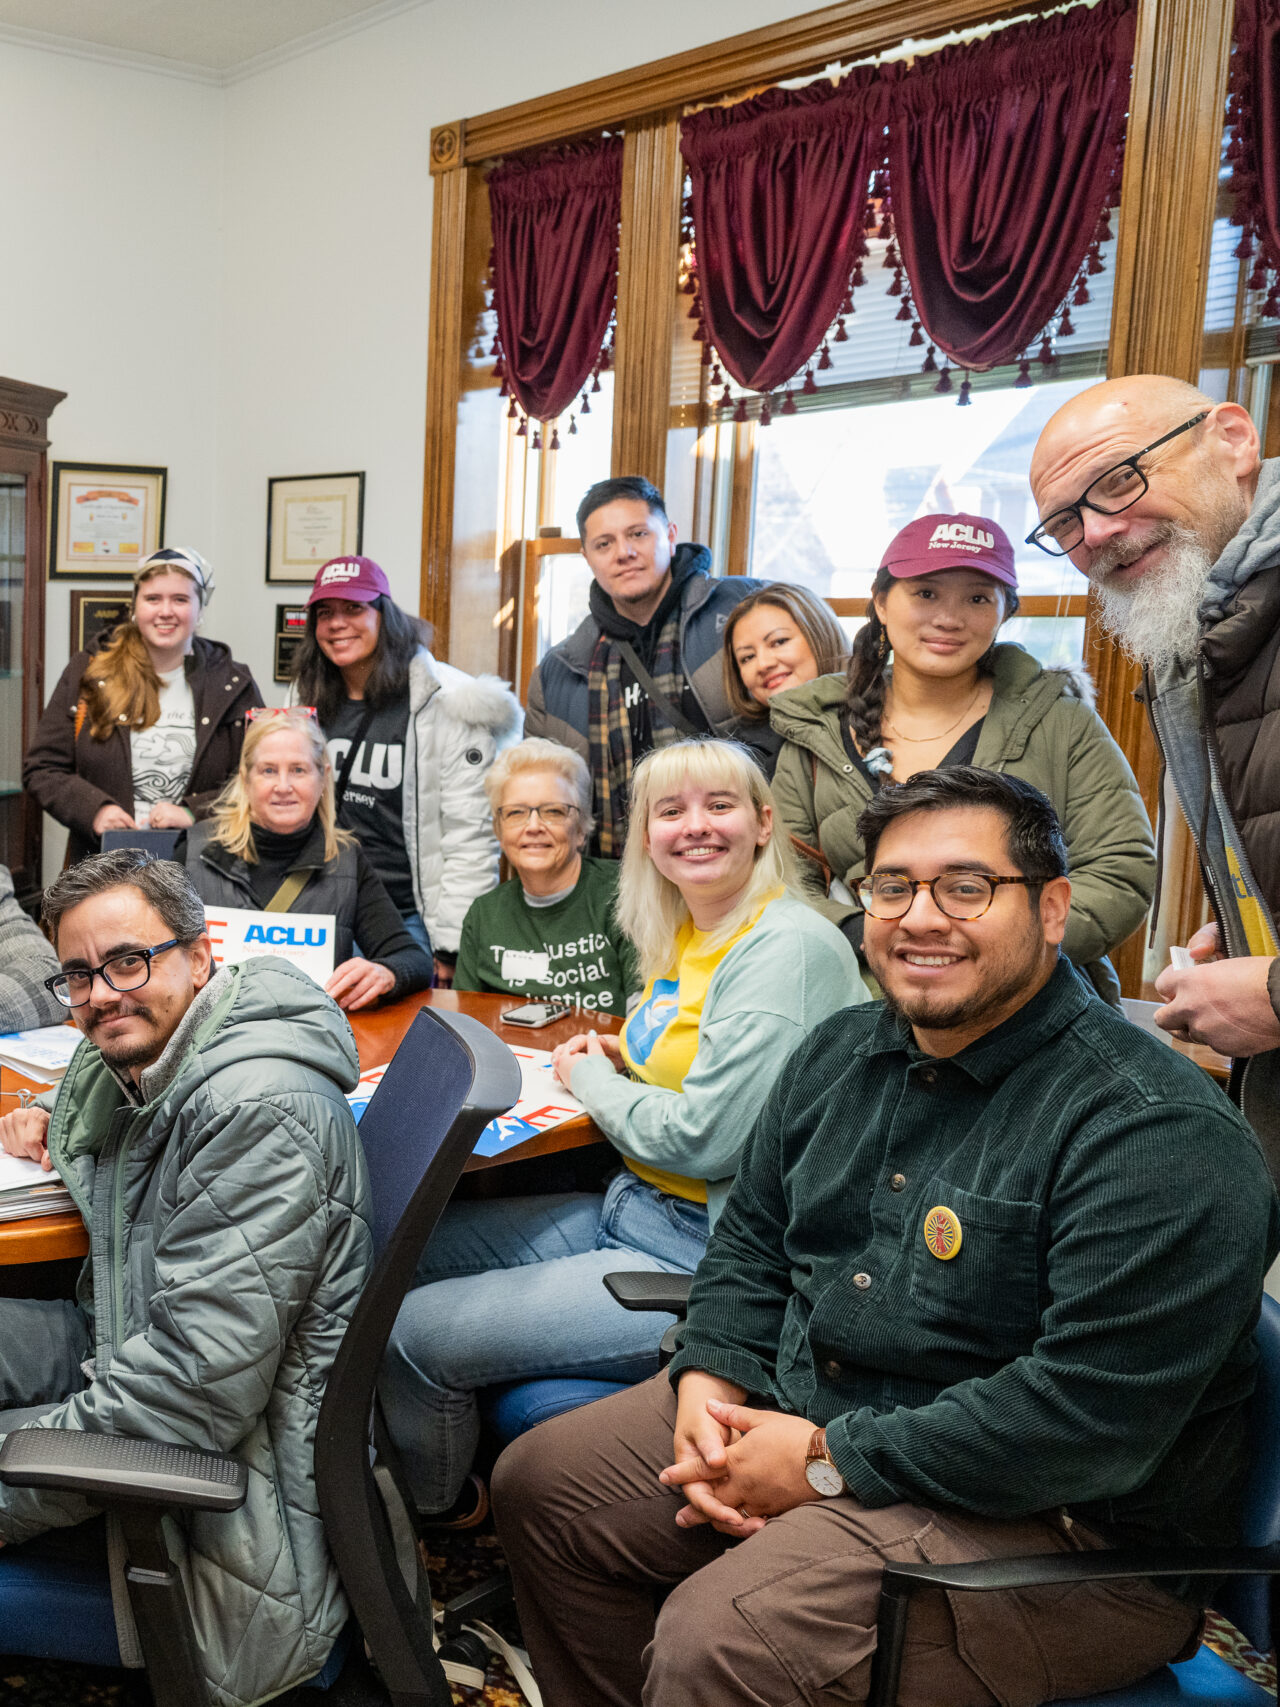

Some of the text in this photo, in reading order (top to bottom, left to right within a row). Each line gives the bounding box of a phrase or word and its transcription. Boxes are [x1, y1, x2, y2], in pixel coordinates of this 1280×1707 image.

[928, 541, 982, 554] New Jersey
[929, 523, 995, 549] ACLU
[321, 562, 360, 580] ACLU
[325, 738, 403, 790] CLU
[343, 790, 375, 809] ersey
[243, 924, 327, 947] ACLU
[543, 933, 611, 962] ustic
[536, 956, 610, 988] social
[525, 990, 614, 1010] tice
